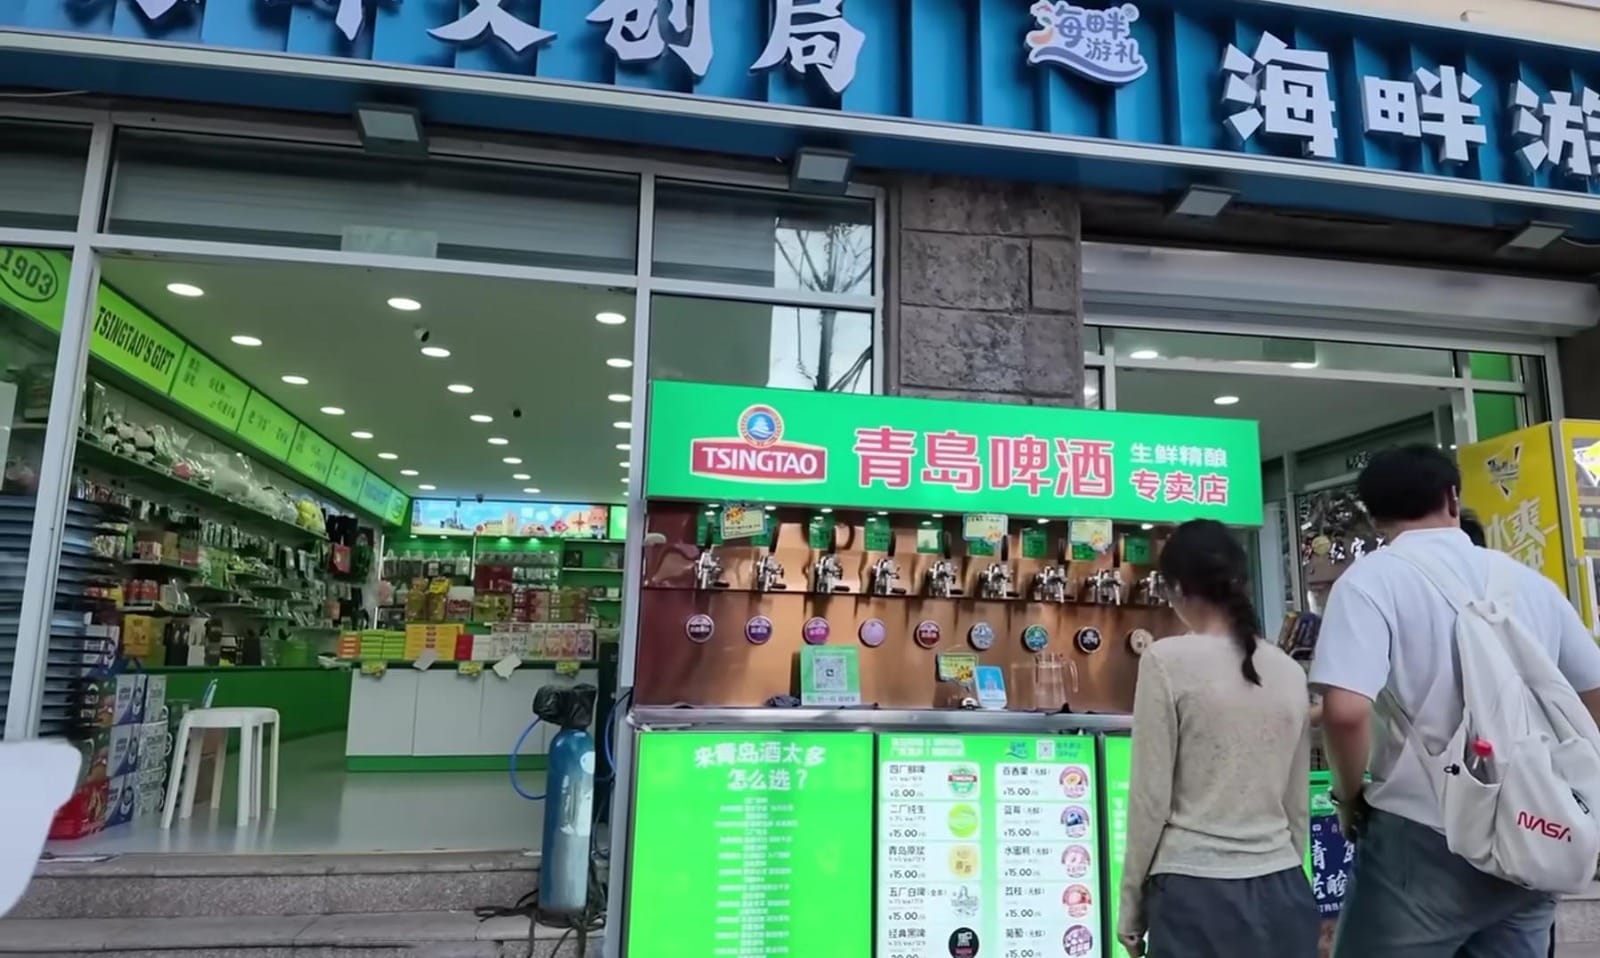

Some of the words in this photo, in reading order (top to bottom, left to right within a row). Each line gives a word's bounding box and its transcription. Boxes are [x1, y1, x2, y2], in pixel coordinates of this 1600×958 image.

[1084, 37, 1140, 65] 游礼
[0, 249, 54, 297] 1903
[94, 306, 155, 364] TSINGTAO'S
[151, 344, 175, 376] GIFT
[701, 446, 818, 475] TSINGTAO
[1130, 443, 1228, 467] 生鲜精酿
[1130, 468, 1229, 505] 专卖店
[1516, 810, 1572, 843] NASA
